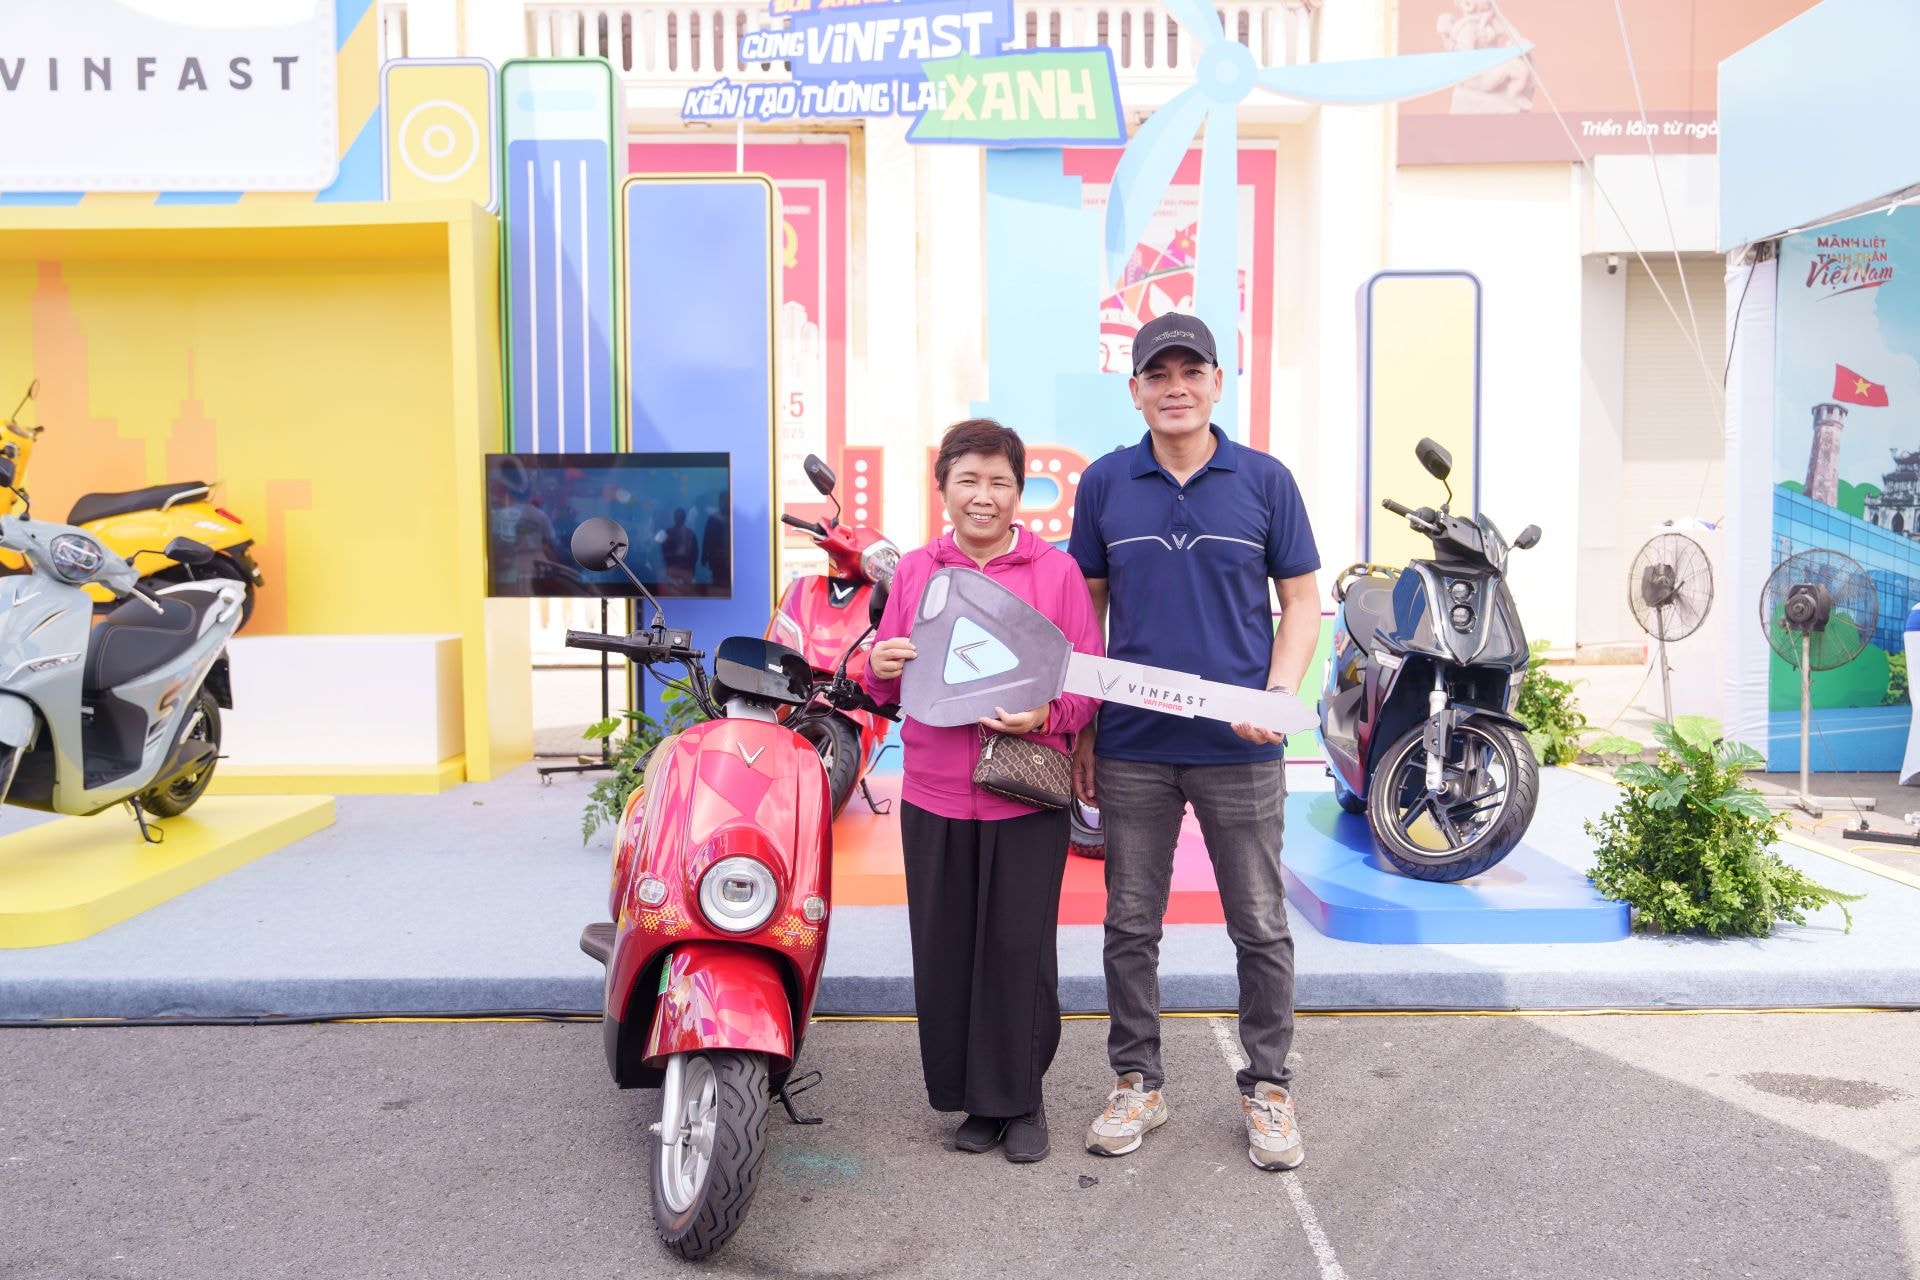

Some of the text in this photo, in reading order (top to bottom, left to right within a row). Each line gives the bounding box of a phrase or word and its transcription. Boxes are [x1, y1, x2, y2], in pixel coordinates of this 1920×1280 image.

[0, 55, 299, 91] VINFAST
[747, 86, 796, 118] TẠO
[941, 68, 1097, 121] XANH
[1581, 118, 1622, 136] Triển
[1128, 683, 1206, 707] VINFAST
